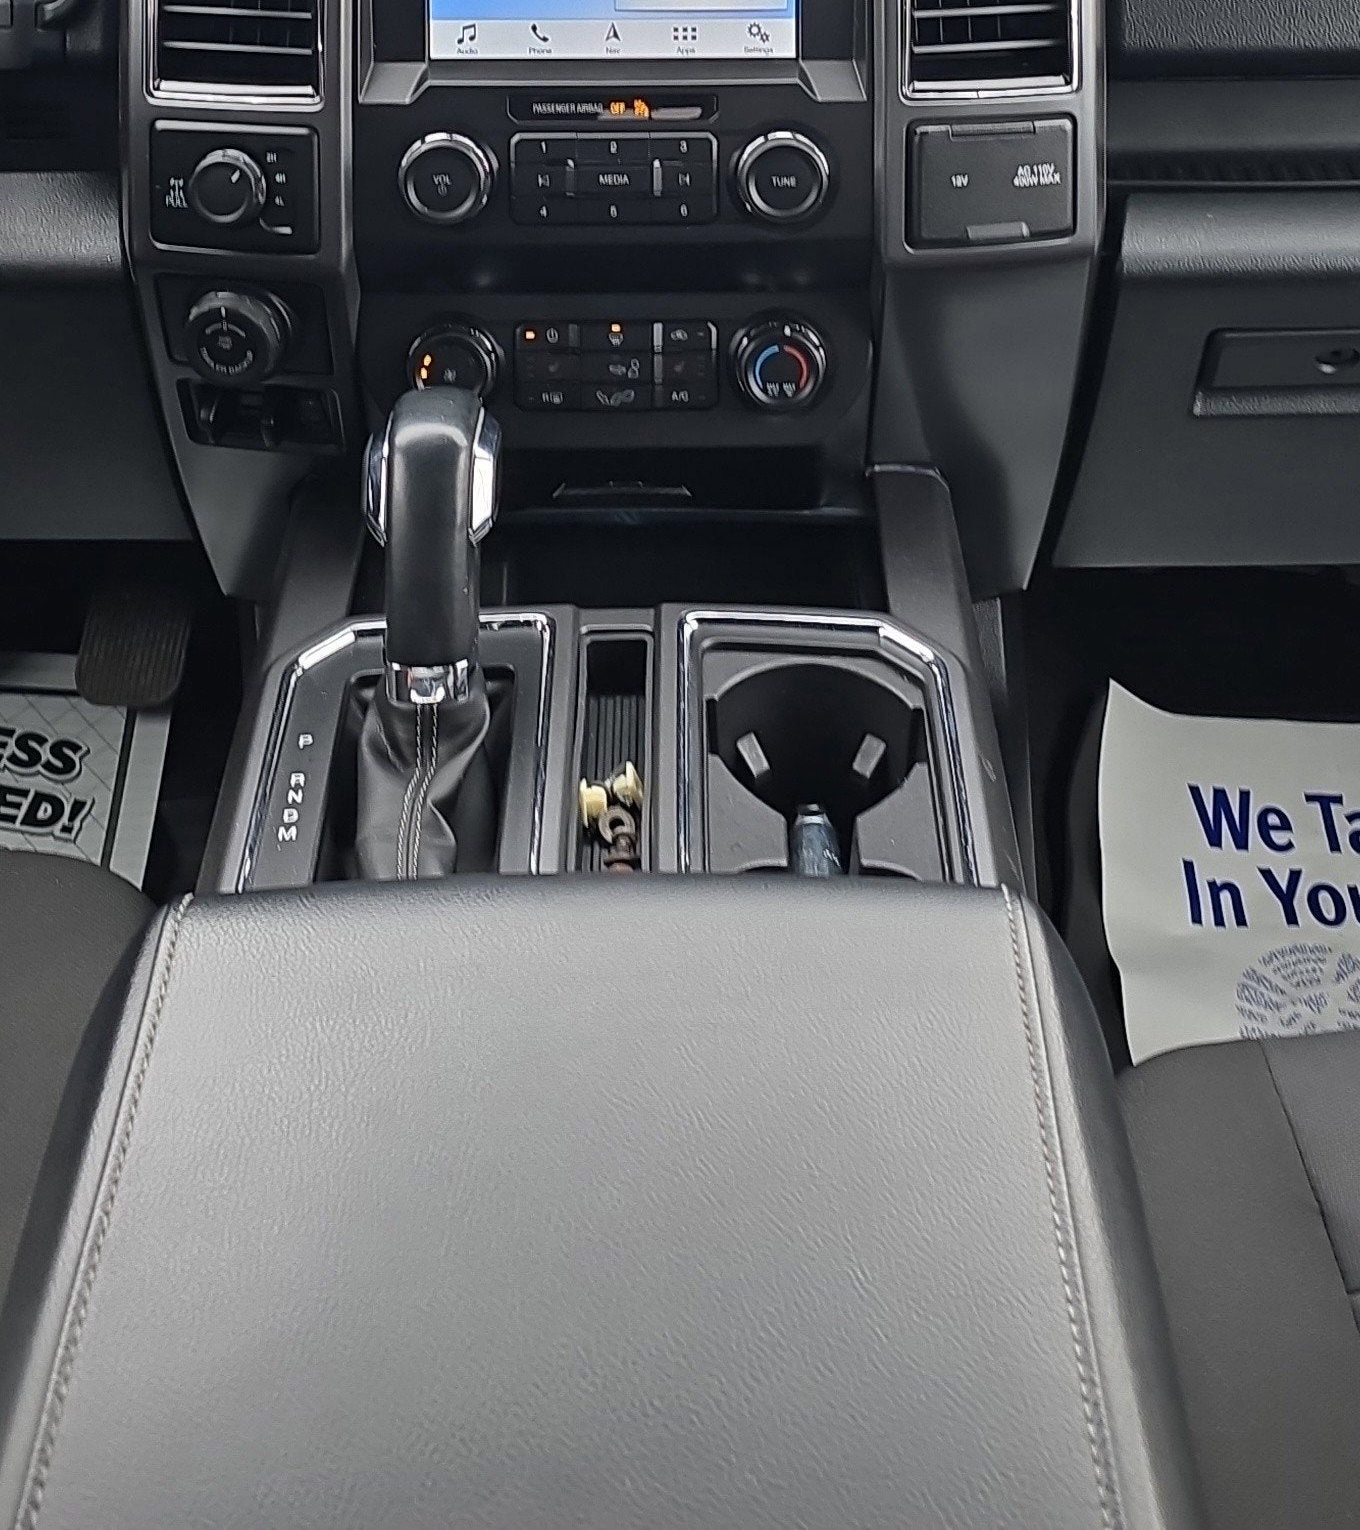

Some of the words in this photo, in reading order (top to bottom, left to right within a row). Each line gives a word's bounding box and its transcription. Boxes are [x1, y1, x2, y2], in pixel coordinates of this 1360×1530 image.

[599, 175, 629, 186] MEDIA
[771, 175, 797, 187] TUNE
[299, 734, 314, 749] P
[291, 772, 305, 787] R
[288, 789, 303, 804] N
[283, 808, 299, 823] D
[1186, 783, 1295, 855] We
[278, 826, 297, 841] M
[1182, 858, 1249, 930] In
